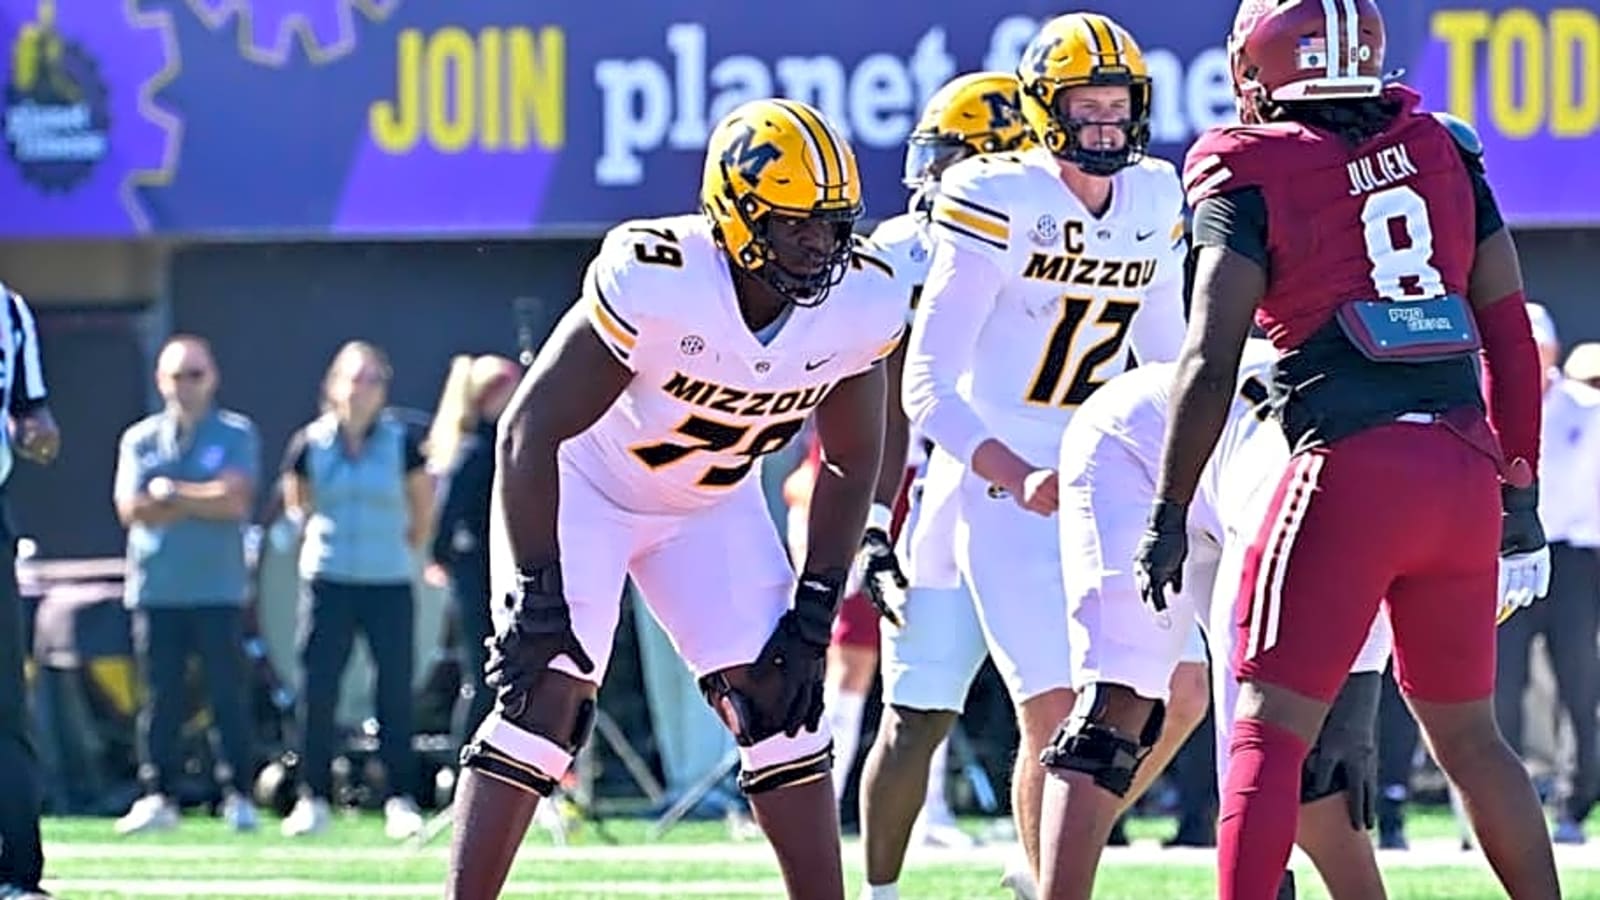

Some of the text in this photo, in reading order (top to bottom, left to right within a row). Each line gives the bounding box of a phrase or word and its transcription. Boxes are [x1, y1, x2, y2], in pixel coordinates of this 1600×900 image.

[369, 27, 565, 153] JOIN
[594, 22, 957, 185] planet
[1431, 9, 1600, 138] TOD
[720, 126, 784, 188] M
[1346, 143, 1418, 196] JULIEN
[1064, 219, 1085, 254] C
[1360, 184, 1446, 302] 8
[1022, 252, 1157, 288] MIZZOU
[1024, 296, 1140, 406] 12
[662, 371, 831, 416] MIZZOU
[627, 413, 806, 487] 79
